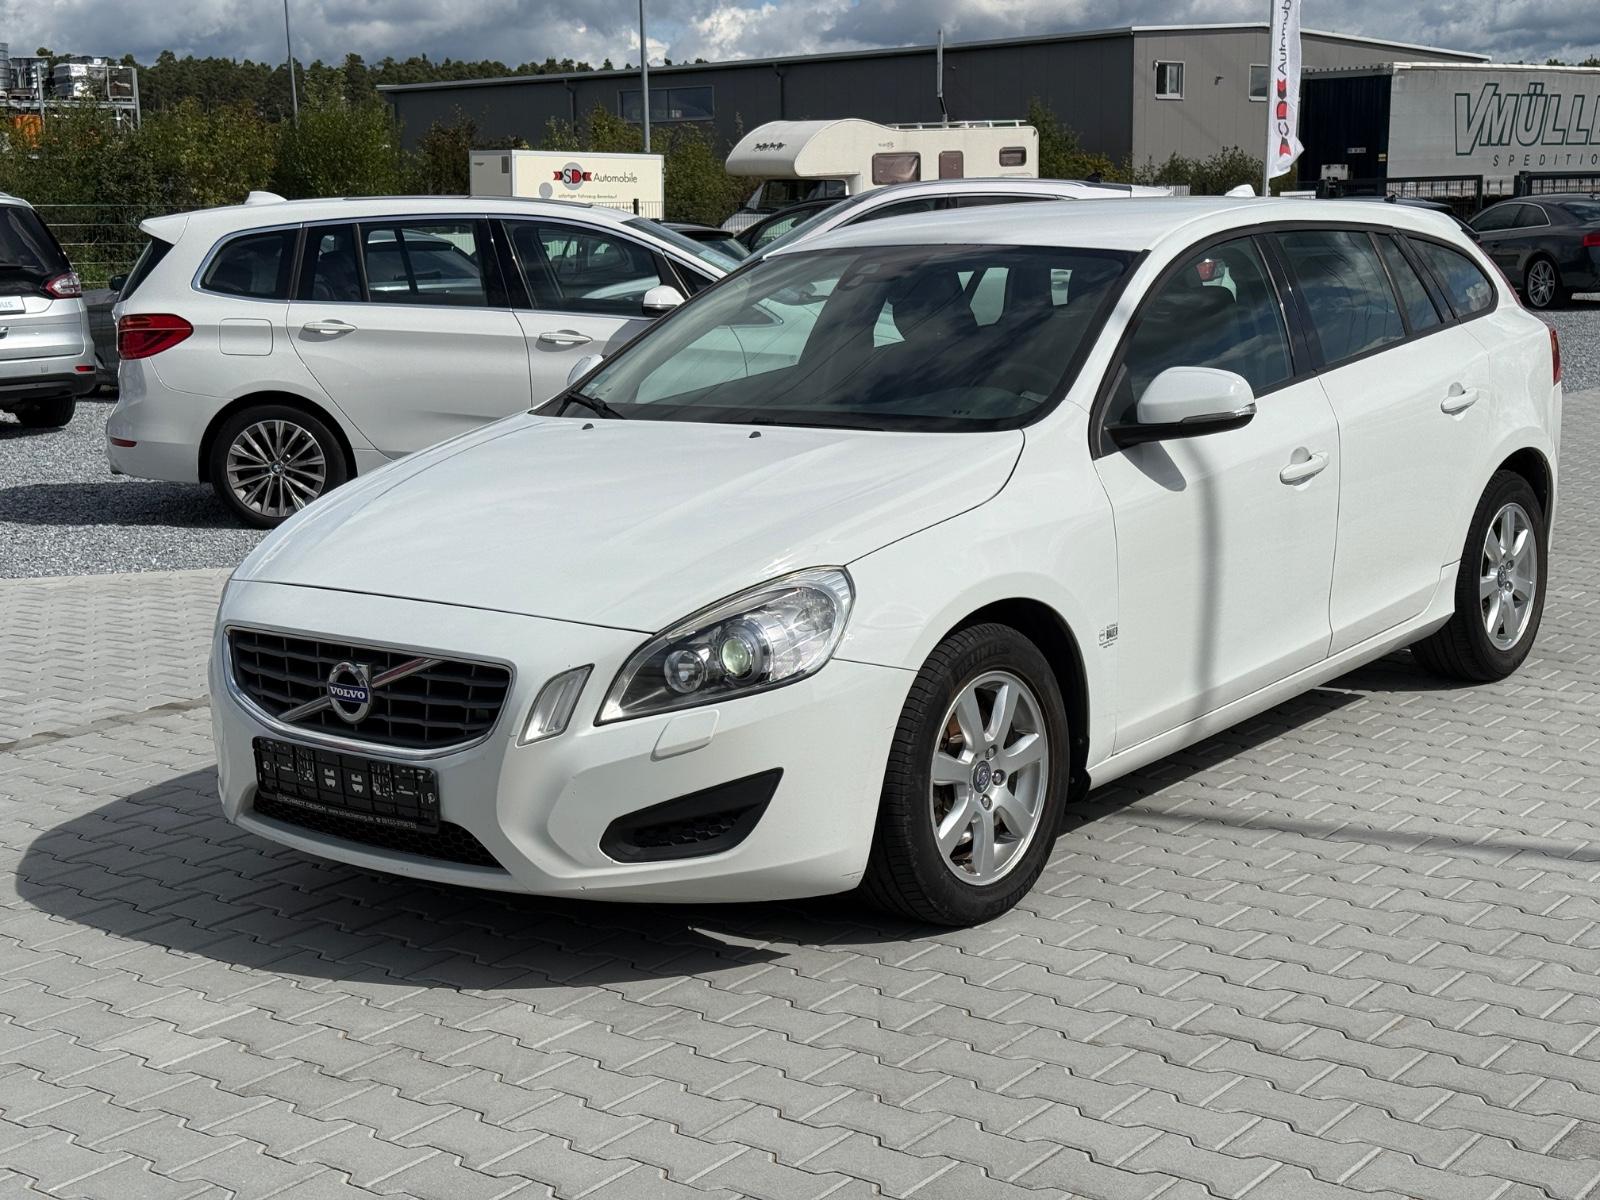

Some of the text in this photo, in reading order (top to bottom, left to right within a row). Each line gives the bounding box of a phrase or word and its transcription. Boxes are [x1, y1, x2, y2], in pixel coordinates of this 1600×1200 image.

[1493, 154, 1598, 167] SPEDITIO
[593, 171, 638, 184] Automobile
[329, 685, 366, 700] VOLVO
